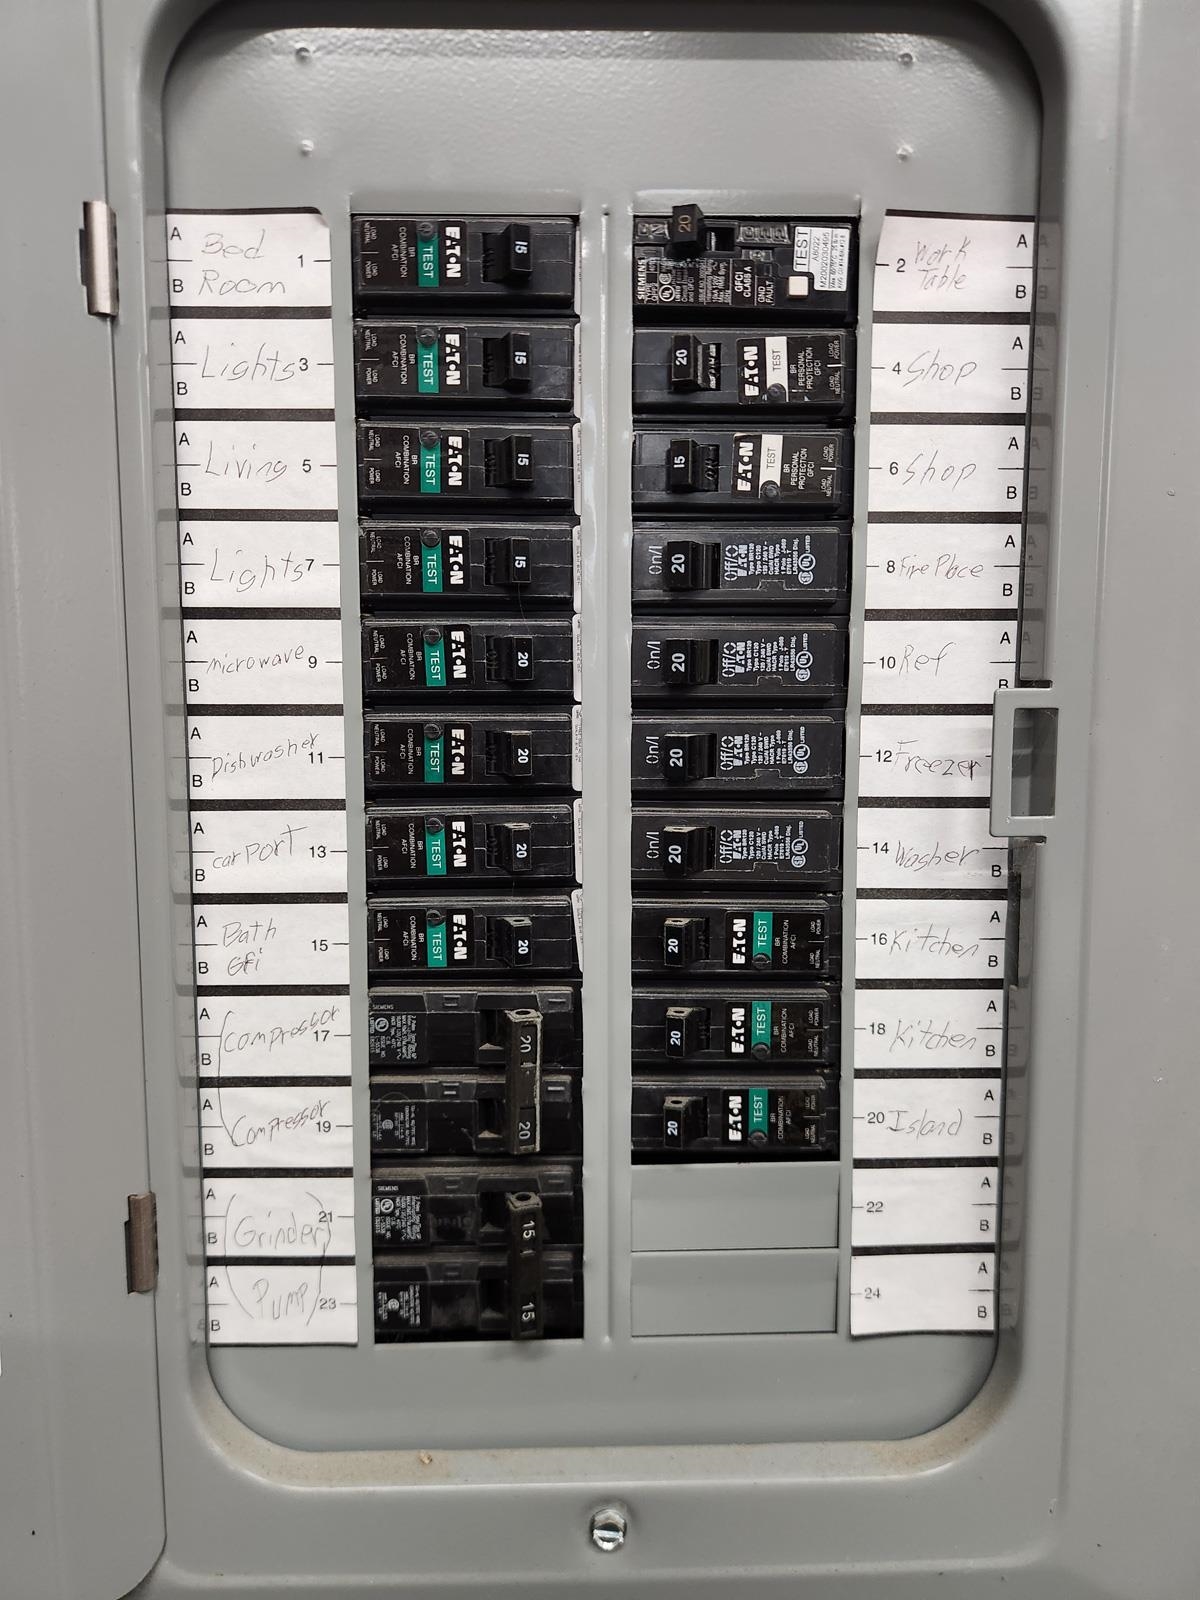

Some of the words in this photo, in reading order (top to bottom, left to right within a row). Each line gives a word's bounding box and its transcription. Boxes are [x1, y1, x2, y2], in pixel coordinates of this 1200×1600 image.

[678, 214, 691, 233] 20
[169, 226, 182, 241] A
[1016, 233, 1028, 249] A
[399, 226, 408, 278] COMBINATION
[445, 226, 462, 278] EATON
[515, 241, 528, 254] 15
[796, 230, 809, 270] TEST
[813, 236, 821, 262] A6022
[297, 254, 304, 268] 1
[422, 245, 434, 279] TEST
[896, 257, 906, 273] 2
[199, 270, 285, 295] Room
[637, 259, 648, 301] SIEMENS
[734, 271, 744, 292] GFCI
[918, 264, 966, 290] Table
[172, 278, 184, 294] B
[765, 281, 774, 303] FAULT
[1015, 284, 1027, 300] B
[174, 330, 186, 345] A
[1011, 336, 1024, 350] A
[202, 343, 295, 381] Lights
[299, 357, 309, 372] 3
[445, 333, 461, 385] EATON
[514, 351, 527, 365] 15
[675, 349, 688, 366] 20
[771, 349, 782, 372] TEST
[422, 352, 434, 385] TEST
[743, 346, 760, 397] EATON
[797, 350, 806, 387] PERSONAL
[805, 347, 814, 390] PROTECTION
[813, 359, 822, 376] GFCI
[891, 361, 902, 375] 4
[903, 349, 977, 387] Shop
[176, 381, 188, 396] B
[1010, 386, 1022, 401] B
[178, 432, 190, 446] A
[1007, 436, 1020, 451] A
[205, 441, 287, 482] Living
[302, 458, 312, 474] 5
[448, 435, 463, 486] EATON
[517, 453, 530, 466] 15
[673, 455, 686, 468] 15
[736, 441, 754, 492] EATON
[766, 447, 776, 470] TEST
[425, 453, 436, 486] TEST
[889, 461, 899, 476] 6
[903, 450, 977, 486] Shop
[180, 482, 192, 497] B
[1006, 485, 1018, 500] B
[182, 532, 194, 546] A
[1004, 534, 1016, 548] A
[305, 558, 315, 572] 7
[448, 535, 464, 585] EATON
[514, 556, 527, 568] 15
[670, 553, 686, 574] 20
[886, 559, 896, 574] 8
[210, 548, 303, 592] Lights
[426, 553, 438, 585] TEST
[184, 581, 196, 595] B
[1002, 583, 1013, 597] B
[186, 630, 198, 644] A
[999, 631, 1011, 645] A
[308, 655, 318, 669] 9
[450, 630, 467, 679] EATON
[517, 651, 529, 668] 20
[671, 652, 686, 673] 20
[899, 642, 957, 675] Ref
[430, 650, 441, 681] TEST
[879, 656, 896, 670] 10
[188, 678, 200, 693] B
[190, 726, 202, 740] A
[308, 751, 323, 764] 11
[430, 742, 440, 773] TEST
[451, 728, 465, 775] EATON
[517, 748, 529, 764] 20
[669, 748, 683, 767] 20
[875, 749, 893, 763] 12
[192, 774, 203, 788] B
[193, 821, 205, 835] A
[309, 844, 327, 859] 13
[408, 823, 417, 869] COMBINATION
[451, 821, 467, 868] EATON
[516, 843, 528, 859] 20
[872, 841, 889, 854] 14
[431, 838, 442, 869] TEST
[668, 844, 682, 864] 20
[194, 868, 206, 882] B
[991, 864, 1002, 878] B
[196, 915, 208, 928] A
[989, 910, 1001, 923] A
[223, 918, 276, 947] Bath
[452, 914, 468, 960] EATON
[757, 918, 768, 948] TEST
[871, 932, 888, 946] 16
[890, 923, 979, 958] Kitchen
[311, 939, 329, 952] 15
[432, 931, 443, 961] TEST
[517, 939, 529, 955] 20
[667, 938, 679, 954] 20
[732, 918, 747, 964] EATON
[197, 961, 209, 975] B
[987, 954, 999, 968] B
[199, 1007, 211, 1021] A
[986, 999, 997, 1013] A
[756, 1007, 766, 1036] TEST
[869, 1022, 886, 1036] 18
[313, 1029, 331, 1042] 17
[670, 1030, 681, 1046] 20
[731, 1007, 745, 1053] EATON
[890, 1019, 976, 1052] Kitchen
[520, 1035, 532, 1053] 20
[985, 1044, 996, 1057] B
[201, 1052, 212, 1066] B
[983, 1089, 995, 1101] A
[202, 1098, 213, 1111] A
[753, 1095, 763, 1123] TEST
[728, 1095, 742, 1141] EATON
[867, 1111, 885, 1124] 20
[315, 1120, 332, 1133] 19
[518, 1121, 531, 1140] 20
[667, 1120, 678, 1136] 20
[982, 1132, 993, 1145] B
[204, 1143, 215, 1156] B
[866, 1201, 884, 1213] 22
[318, 1210, 333, 1223] 21
[522, 1220, 536, 1239] 15
[864, 1287, 881, 1300] 24
[319, 1297, 337, 1310] 23
[521, 1302, 536, 1321] 15
